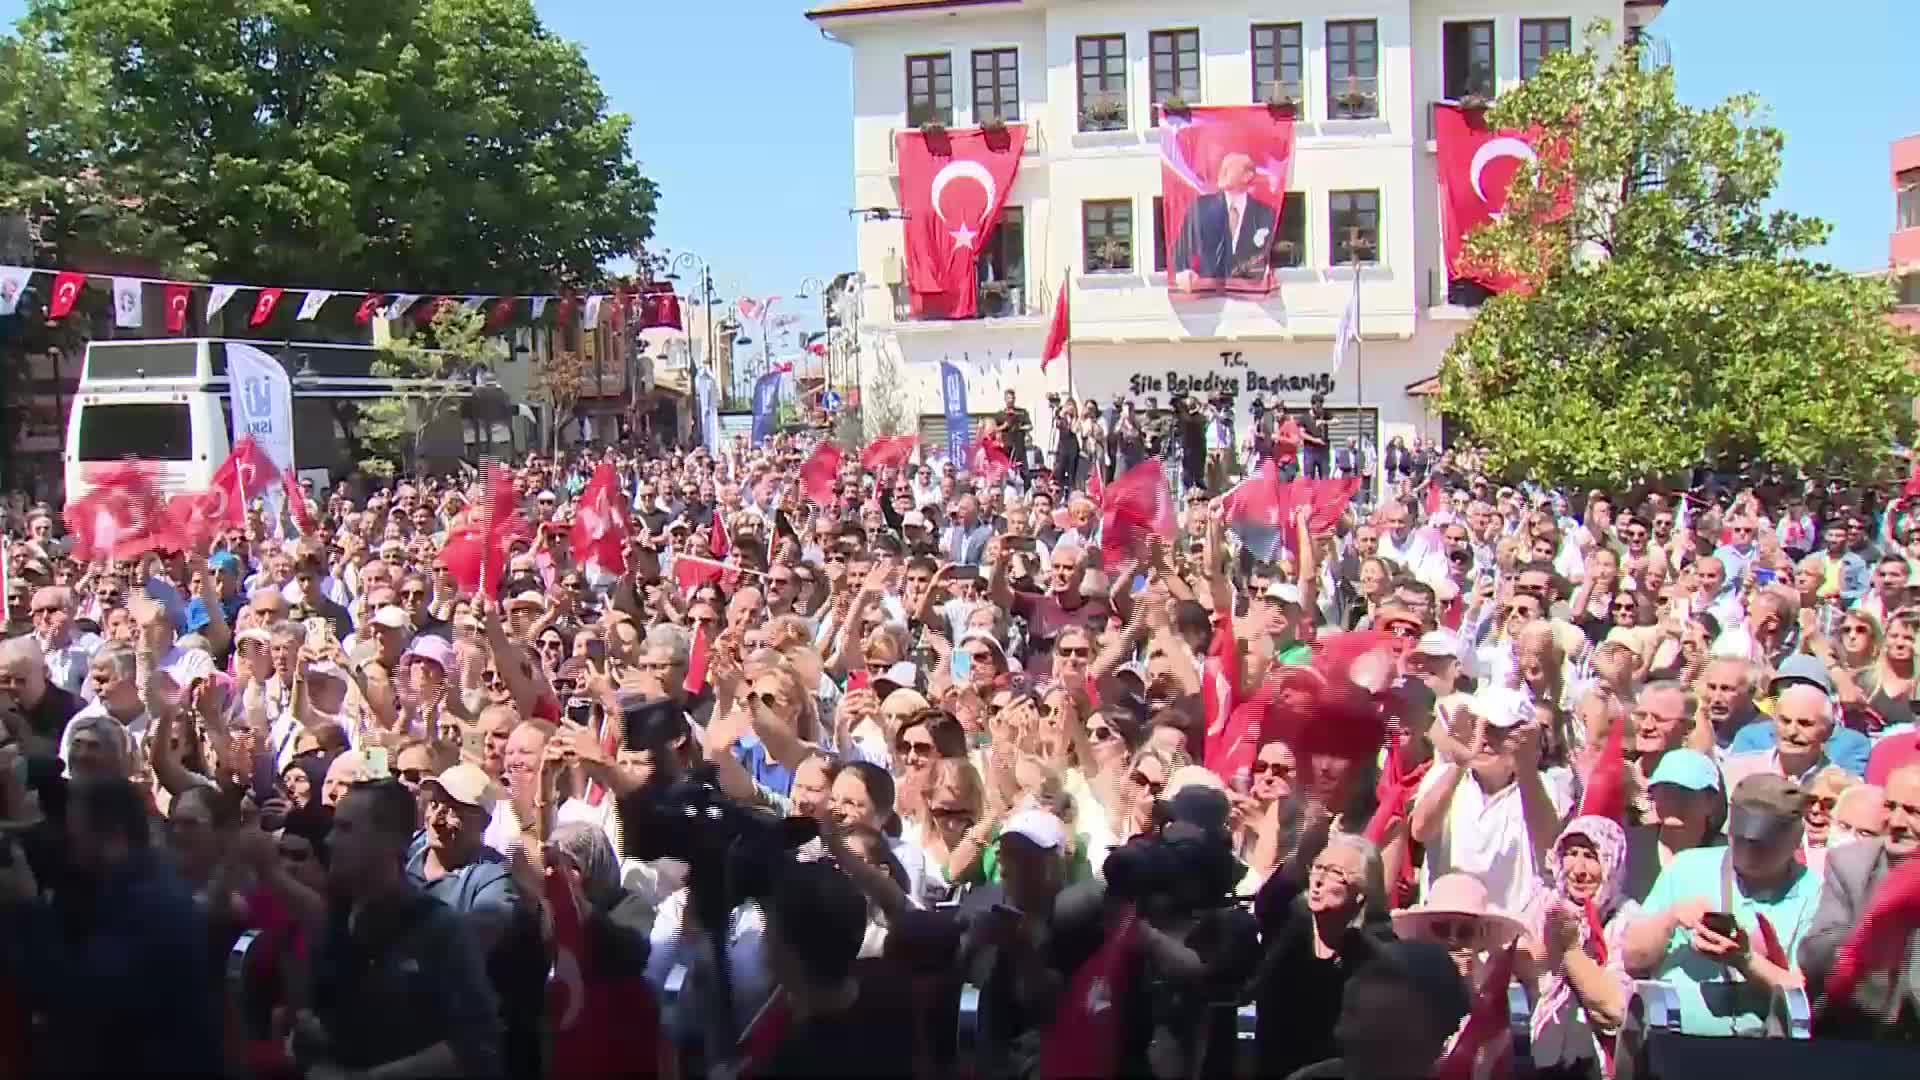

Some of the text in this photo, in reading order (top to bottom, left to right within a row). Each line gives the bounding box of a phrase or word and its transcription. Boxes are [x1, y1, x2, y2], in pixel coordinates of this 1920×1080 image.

[1219, 351, 1248, 368] T.C.
[1129, 370, 1335, 396] Şile Belediye Başkanlığı
